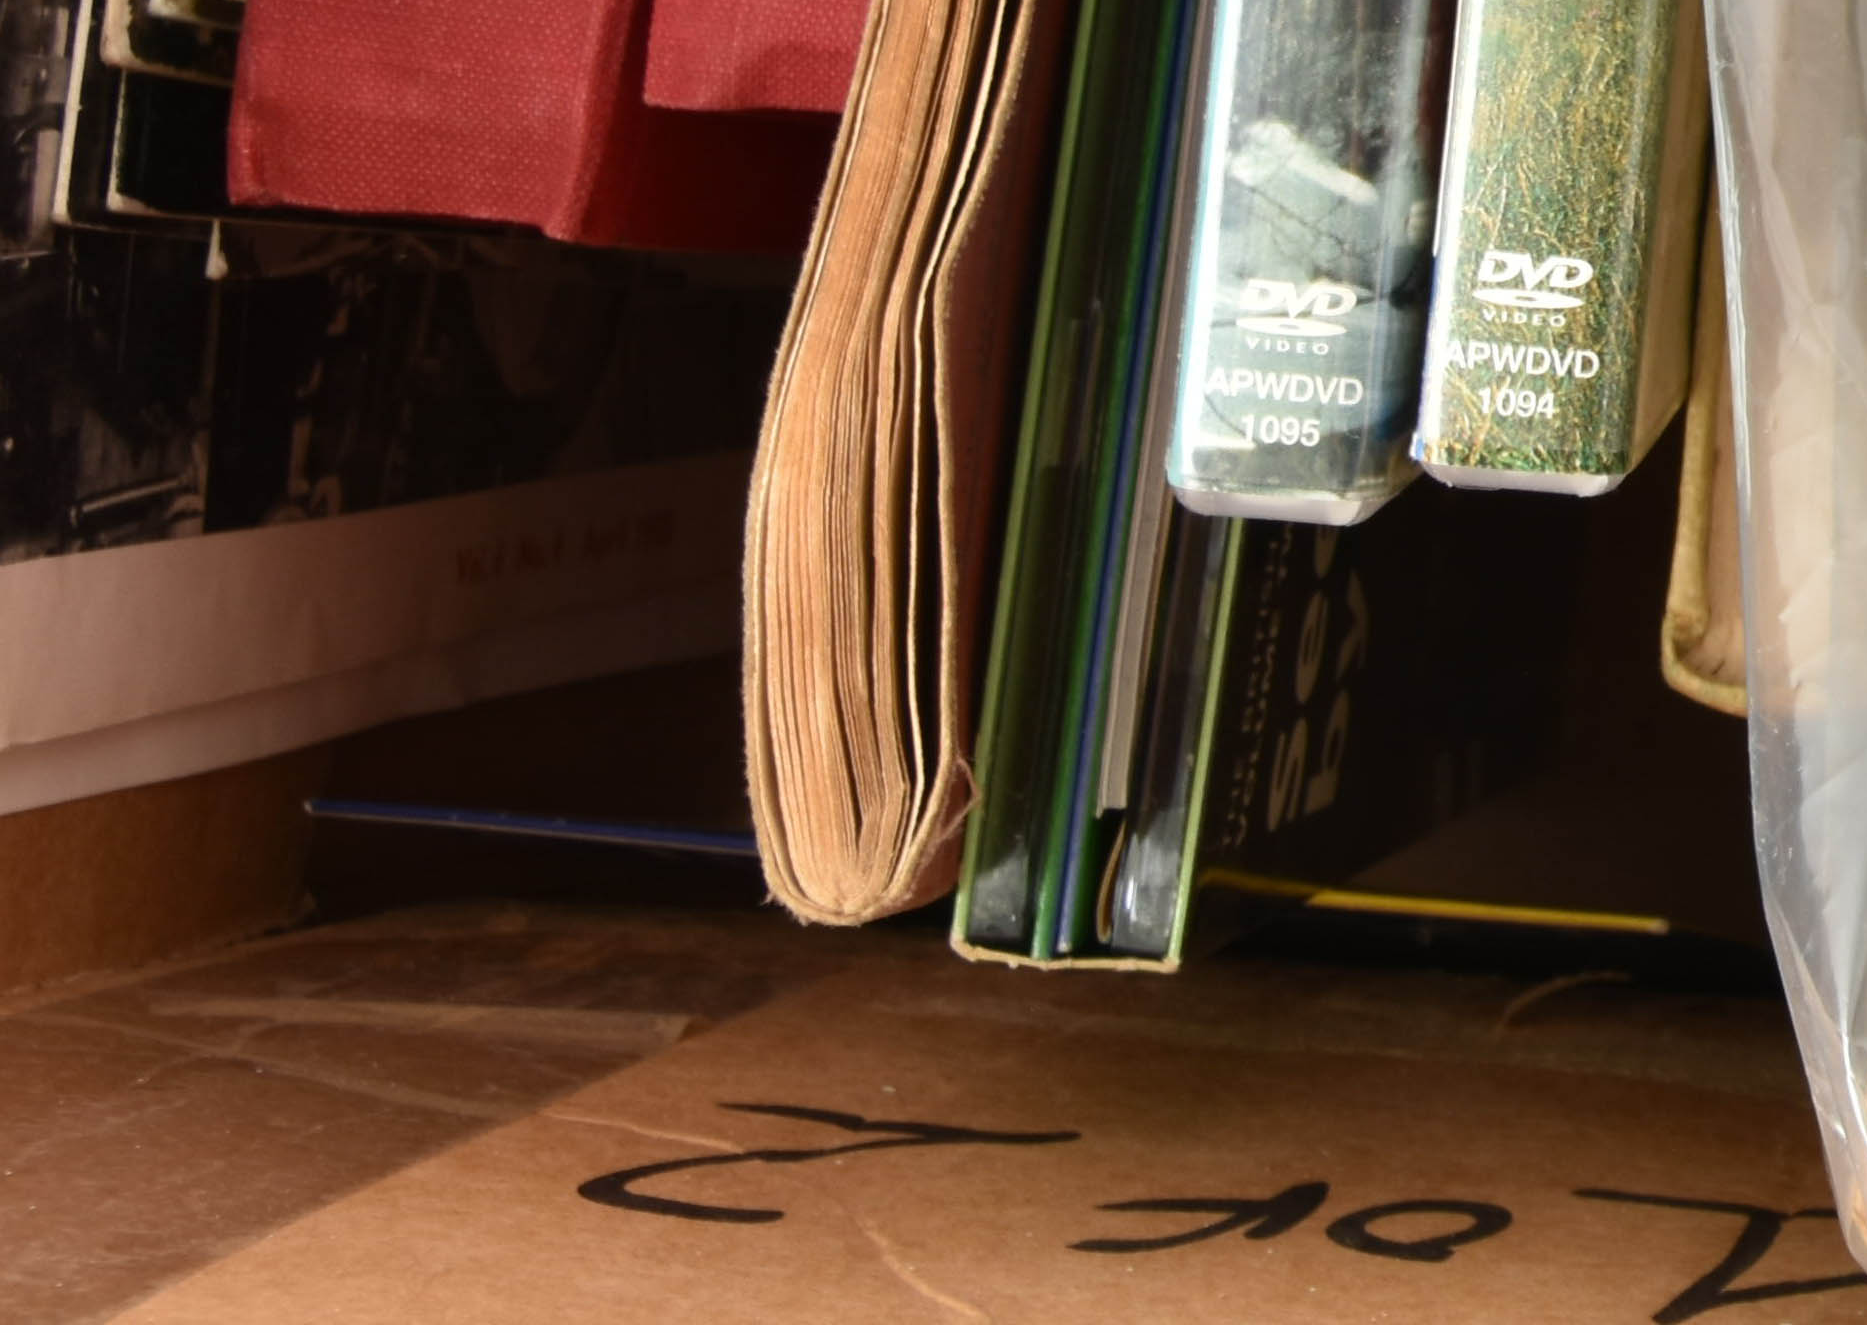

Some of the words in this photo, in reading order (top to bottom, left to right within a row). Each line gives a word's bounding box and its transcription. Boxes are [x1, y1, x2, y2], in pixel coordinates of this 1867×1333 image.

[1476, 249, 1595, 291] DVD
[1238, 278, 1358, 318] DVD
[1481, 307, 1568, 329] VIDEO
[1244, 336, 1331, 357] VIDEO
[1442, 338, 1600, 381] APWDVD
[1203, 364, 1364, 408] APWDVD
[1476, 385, 1557, 421] 1094
[1240, 412, 1321, 449] 1095
